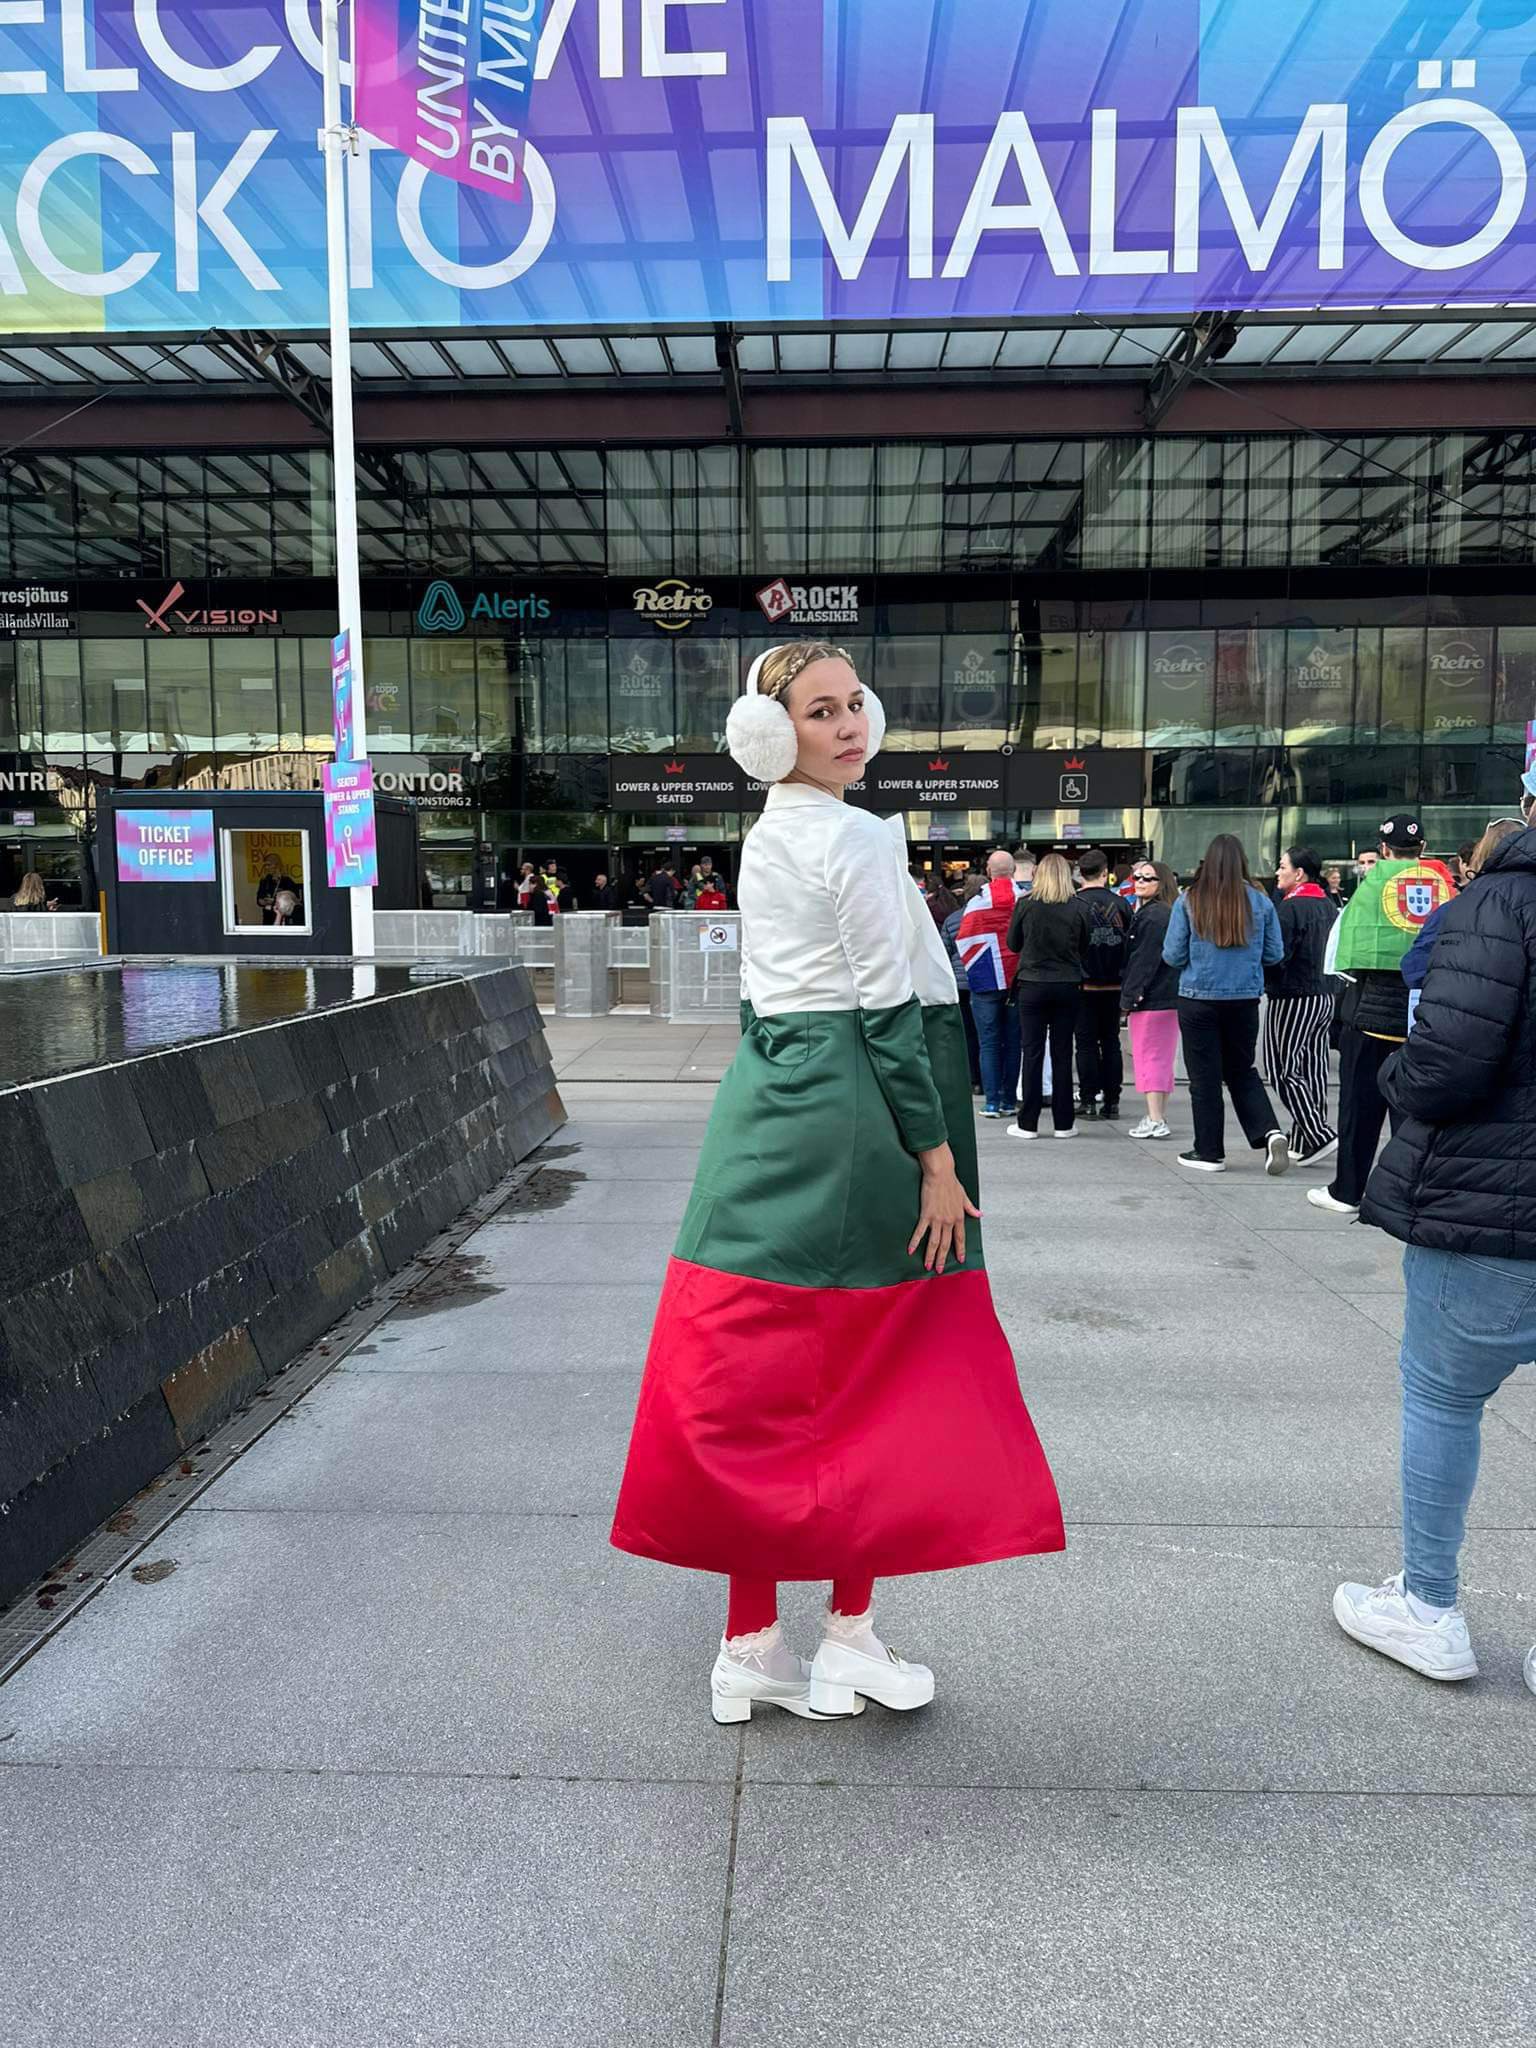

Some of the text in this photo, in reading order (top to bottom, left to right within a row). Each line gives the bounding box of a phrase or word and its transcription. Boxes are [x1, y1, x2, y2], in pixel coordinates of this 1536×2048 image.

[470, 98, 519, 184] BY
[0, 59, 1528, 296] CK TO MALMÖ
[633, 588, 713, 612] Retro
[790, 586, 858, 610] ROCK
[471, 592, 551, 619] Aleris
[789, 611, 859, 623] KLASSIKER
[1153, 656, 1207, 673] Retro
[1431, 655, 1485, 670] Retro
[953, 670, 996, 684] ROCK
[1298, 666, 1342, 680] ROCK
[620, 675, 661, 688] ROCK
[616, 782, 734, 792] LOWER & UPPER STANDS
[878, 779, 999, 790] LOWER & UPPER STANDS
[465, 798, 472, 806] 2
[656, 794, 694, 804] SEATED
[919, 792, 957, 801] SEATED
[138, 826, 191, 844] TICKET
[138, 849, 194, 866] OFFICE
[251, 849, 268, 863] BY
